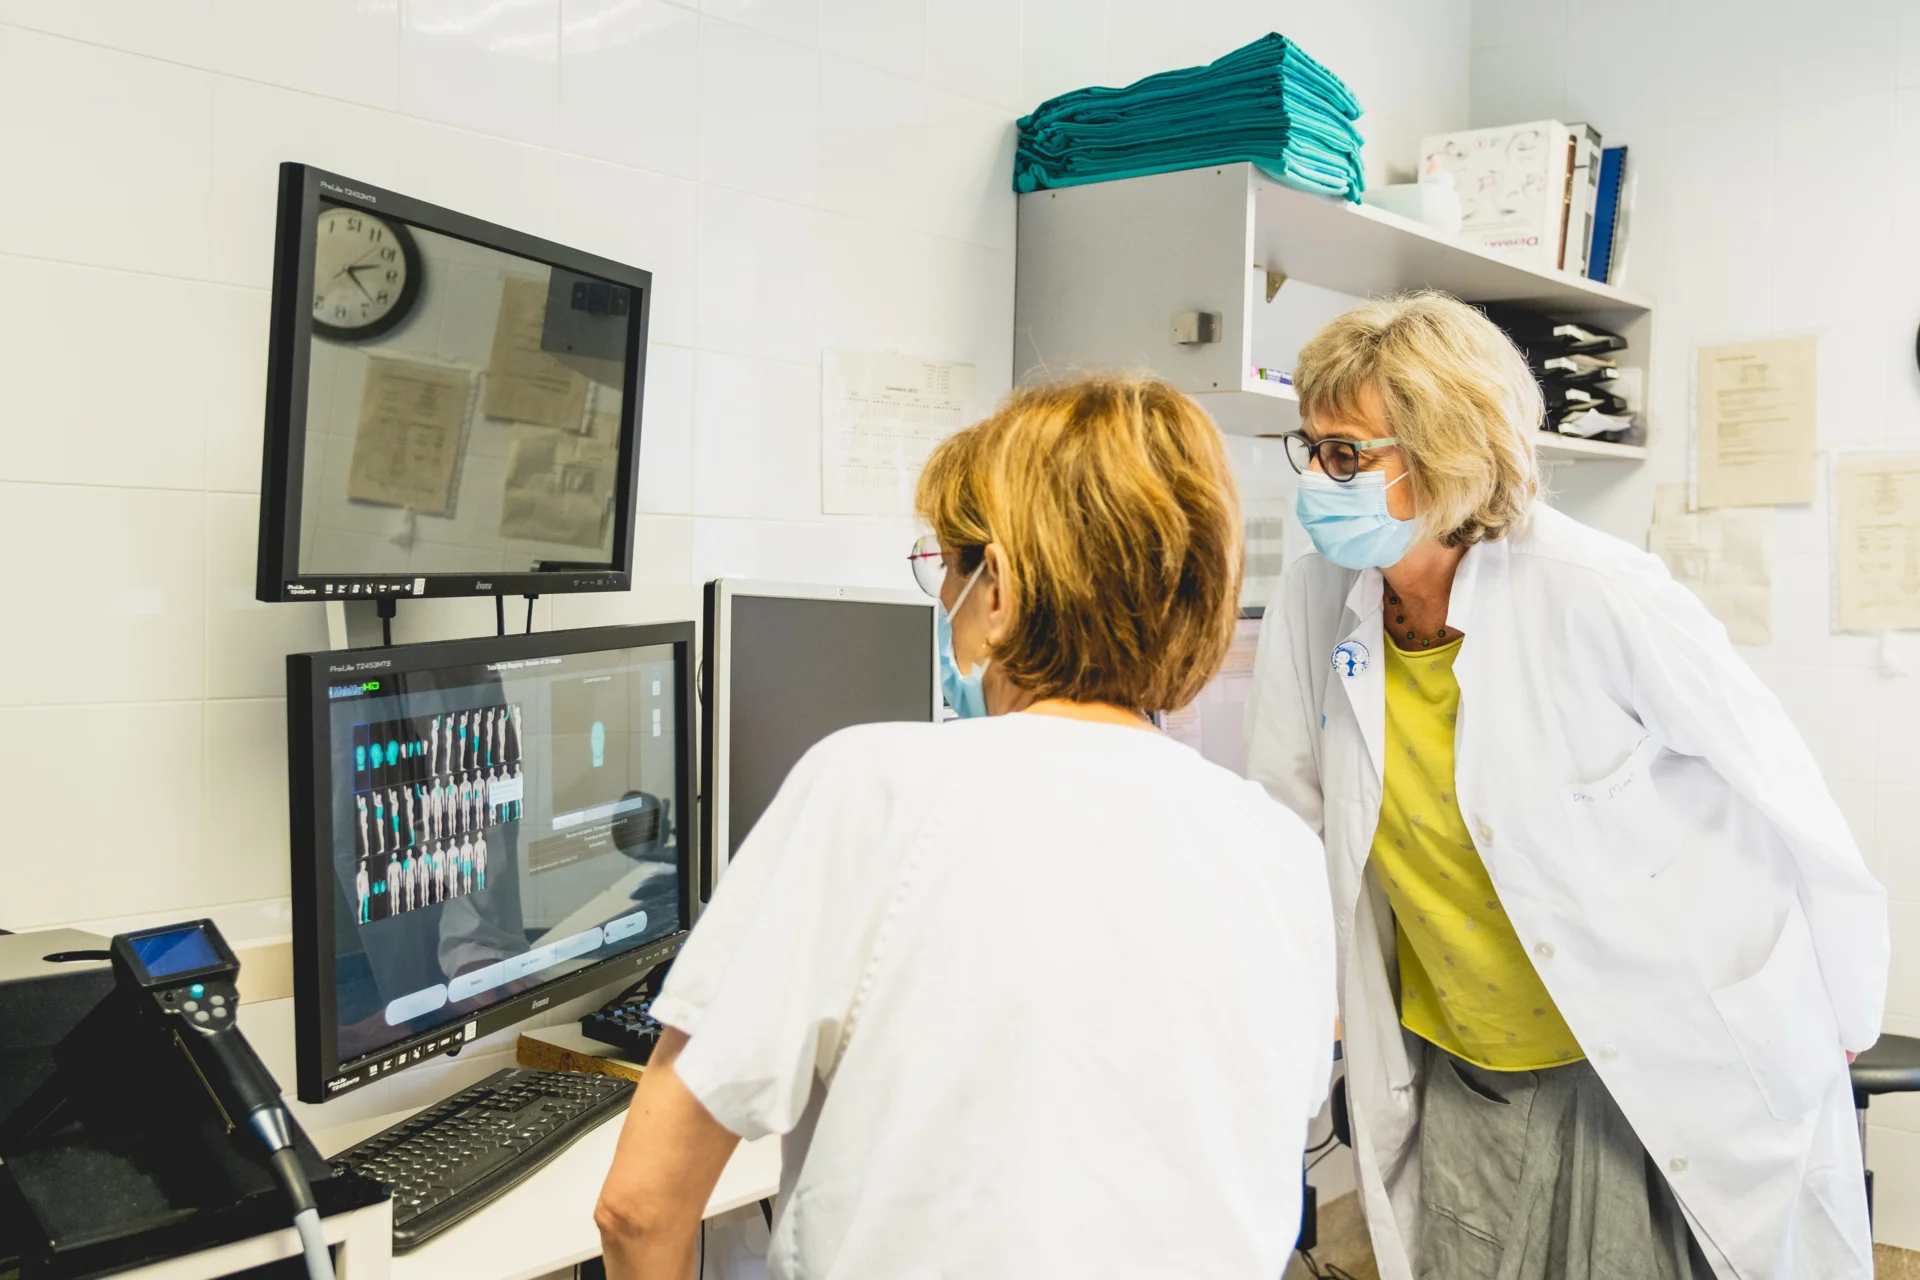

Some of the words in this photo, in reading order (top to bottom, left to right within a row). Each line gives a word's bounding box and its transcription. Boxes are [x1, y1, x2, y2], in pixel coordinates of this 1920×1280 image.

[320, 180, 343, 193] ProLite
[330, 664, 355, 673] ProLite
[356, 660, 392, 671] T2453MTS
[531, 996, 550, 1010] iiyama
